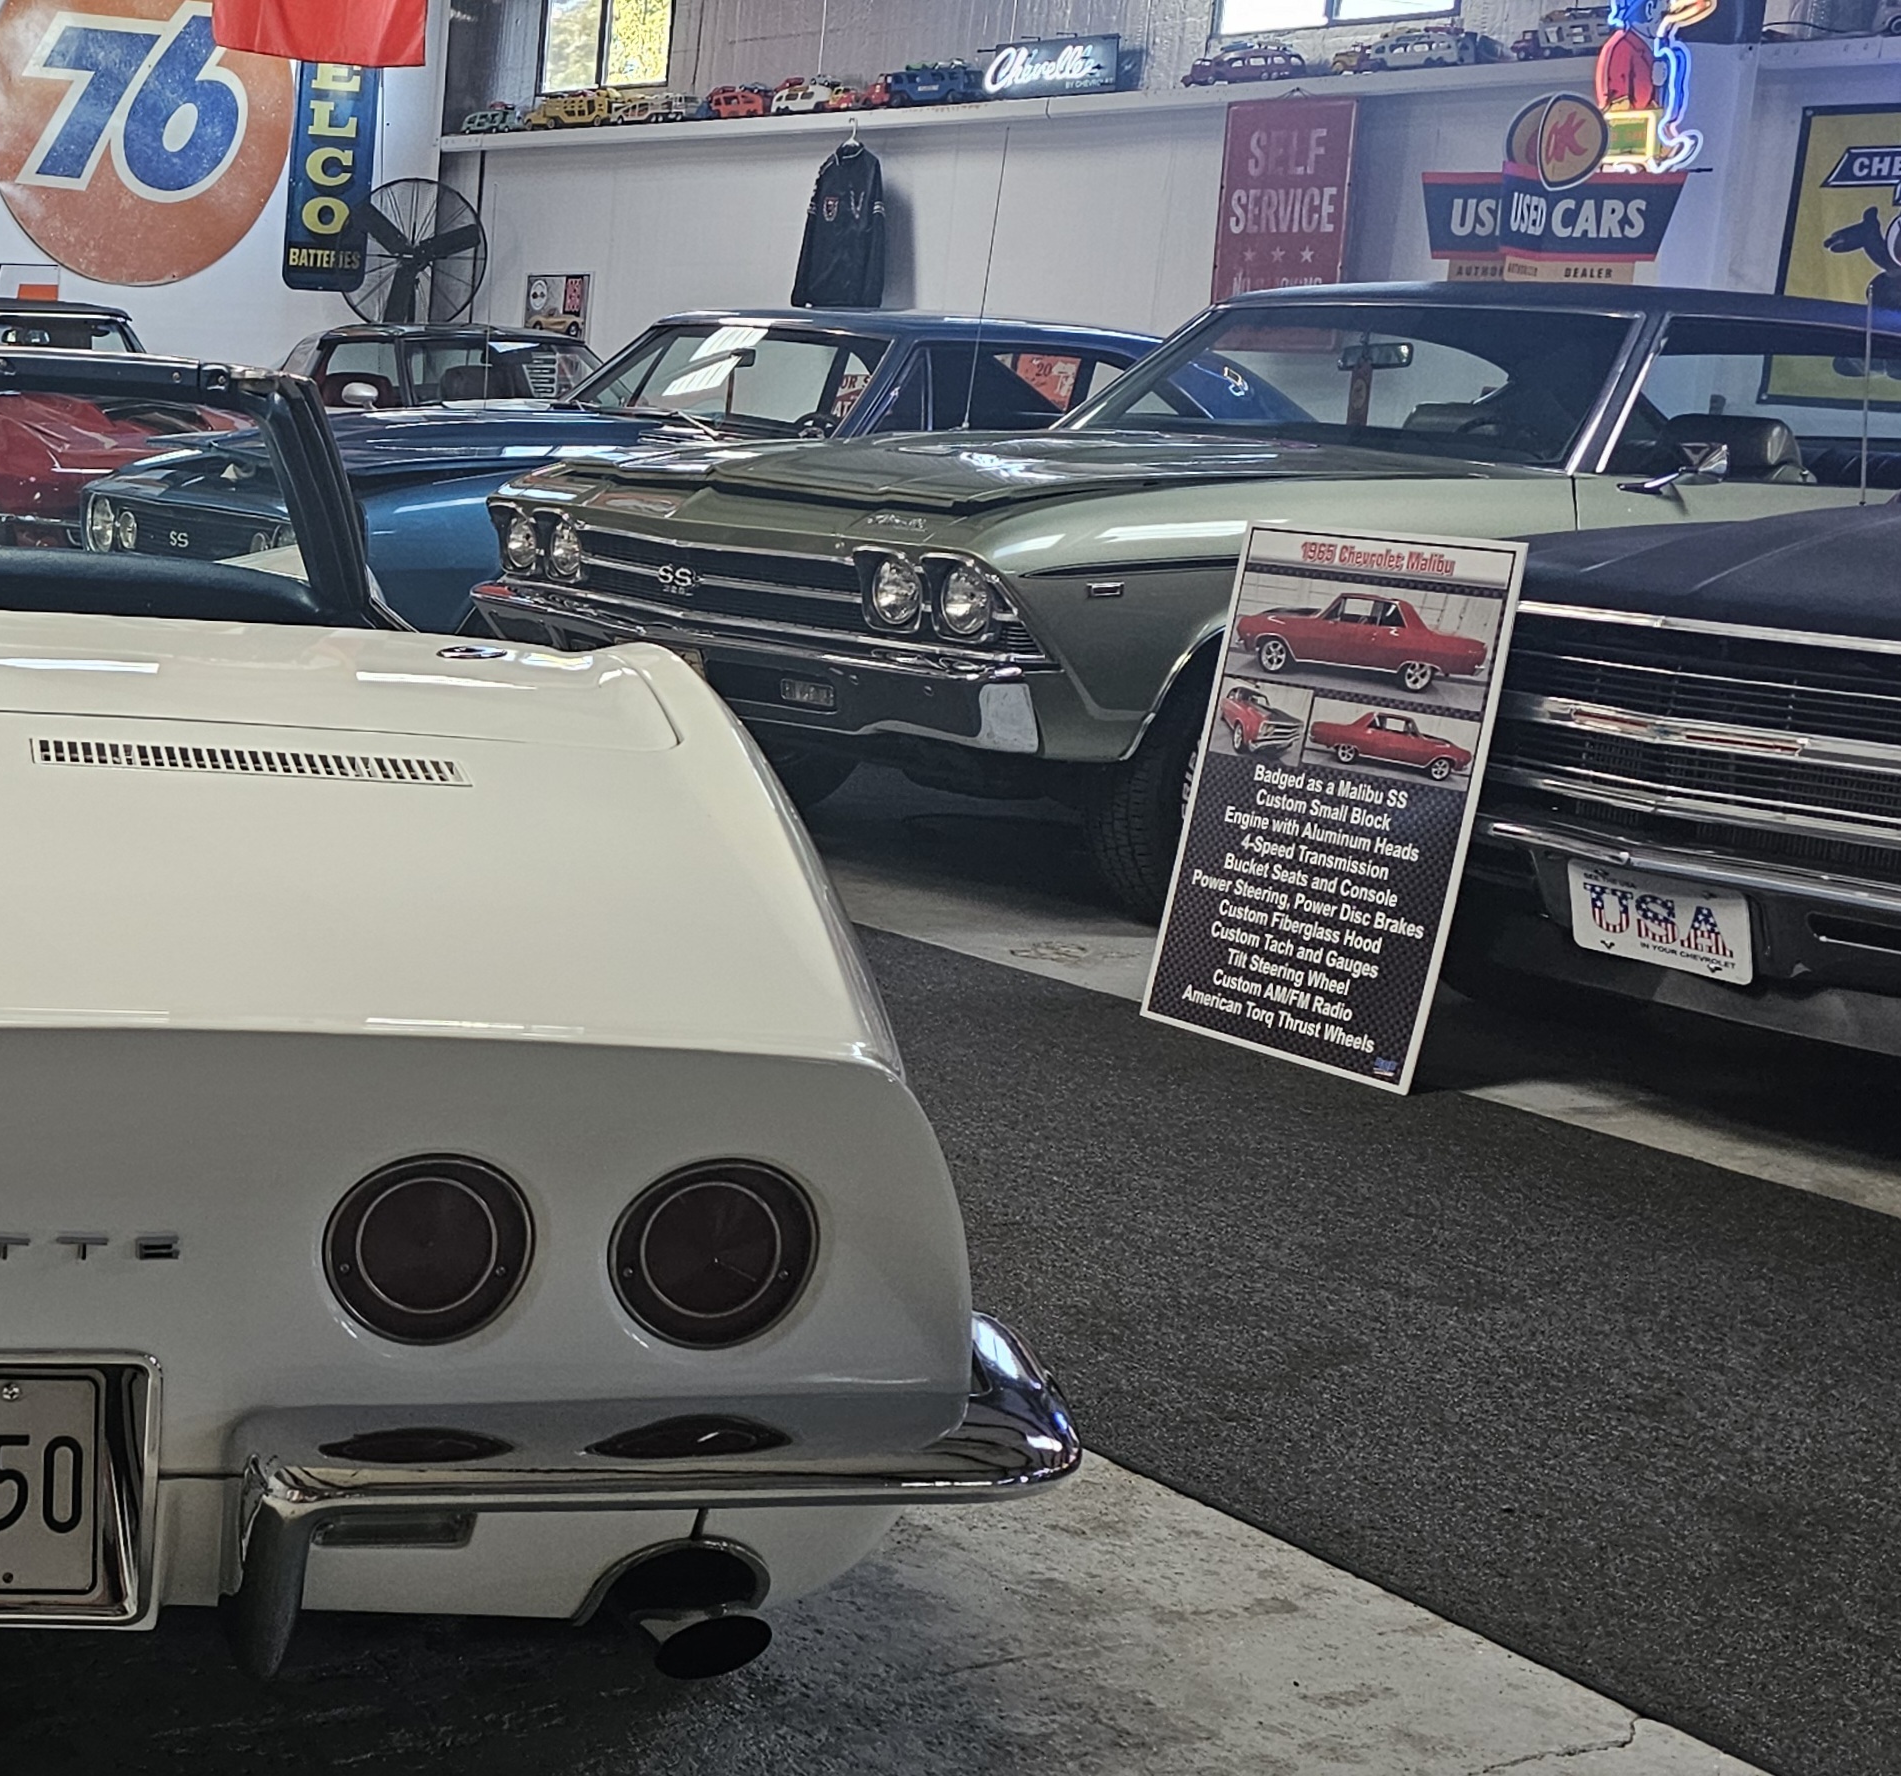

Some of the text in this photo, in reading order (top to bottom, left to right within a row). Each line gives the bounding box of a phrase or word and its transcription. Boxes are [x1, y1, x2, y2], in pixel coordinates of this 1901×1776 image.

[984, 45, 1099, 94] Chevelle
[14, 2, 248, 203] 76
[1248, 128, 1327, 176] SELF
[1229, 187, 1338, 234] SERVICE
[1510, 191, 1647, 238] USED CARS
[1564, 268, 1613, 279] DEALER
[169, 530, 189, 547] SS
[1301, 541, 1456, 576] 1965 Chevrolet Malibu
[659, 565, 692, 587] SS
[1254, 764, 1408, 808] Badged as a Malibu SS
[1256, 788, 1391, 831] Custom Small Block
[1224, 806, 1419, 862] Engine with Aluminum Heads
[1241, 834, 1389, 880] 4-Speed Transmission
[1192, 869, 1425, 940] Power Steering, Power Disc Brakes
[1224, 853, 1398, 908] Bucket Seats and Console
[1219, 900, 1383, 954] Custom Fiberglass Hood
[1583, 882, 1734, 958] USA
[1211, 921, 1379, 979] Custom Tach and Gauges
[1228, 948, 1351, 996] Tilt Steering Wheel
[1652, 945, 1678, 956] YOUR
[1679, 950, 1736, 969] CHEVROLET
[1182, 984, 1375, 1054] American Torq Thrust Wheels
[1213, 969, 1353, 1022] Custom AM/FM Radio
